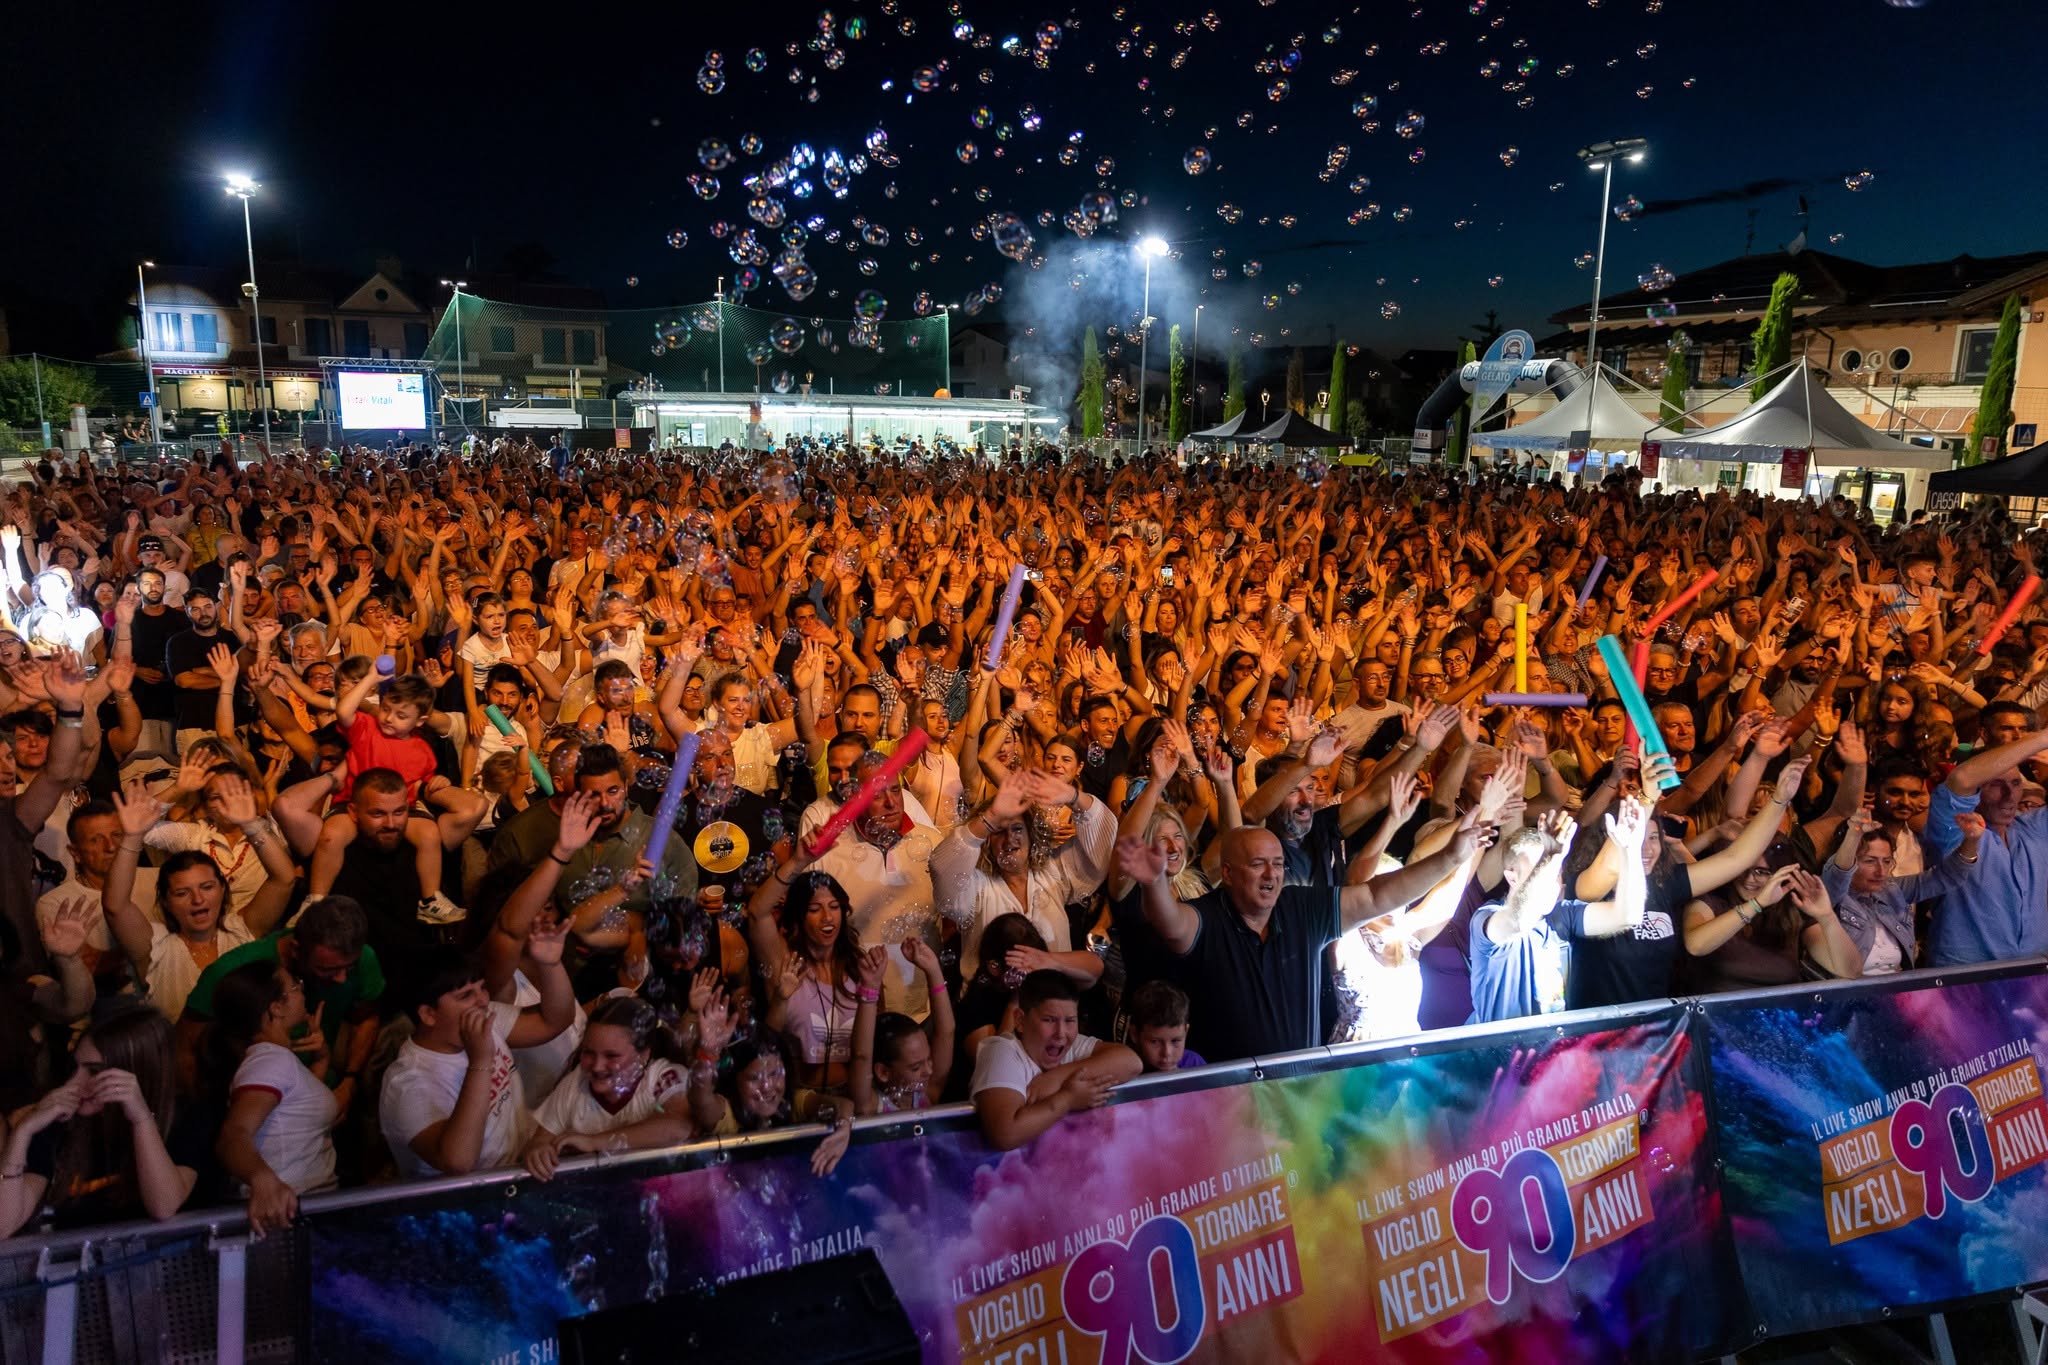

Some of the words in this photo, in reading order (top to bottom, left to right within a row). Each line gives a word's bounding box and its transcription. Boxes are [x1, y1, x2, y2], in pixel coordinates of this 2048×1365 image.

[1481, 371, 1511, 382] GELATO
[1930, 491, 1961, 510] CASSA
[1357, 1200, 1371, 1220] IL
[1375, 1185, 1404, 1214] LIVE
[1408, 1168, 1445, 1201] SHOW
[1448, 1153, 1478, 1183] ANNI
[1481, 1145, 1498, 1168] 90
[1501, 1130, 1523, 1160] PIÙ
[1527, 1114, 1579, 1147] GRANDE
[1581, 1093, 1637, 1129] D'ITALIA
[1811, 1122, 1823, 1141] IL
[1823, 1111, 1847, 1136] LIVE
[1849, 1097, 1883, 1125] SHOW
[1885, 1086, 1910, 1112] ANNI
[1911, 1080, 1927, 1100] 90
[1928, 1068, 1948, 1093] PIÙ
[1951, 1055, 1987, 1083] GRANDE
[1988, 1038, 2031, 1068] D'ITALIA
[1828, 1131, 1881, 1177] VOGLIO
[1976, 1064, 2038, 1113] TORNARE
[952, 1276, 966, 1300] IL
[972, 1260, 1006, 1293] LIVE
[1010, 1240, 1056, 1276] SHOW
[1064, 1224, 1101, 1257] ANNI
[1107, 1214, 1126, 1240] 90
[1130, 1197, 1155, 1229] PIÙ
[1160, 1176, 1218, 1214] GRANDE
[1222, 1152, 1284, 1192] D'ITALIA
[1374, 1206, 1441, 1261] VOGLIO
[1559, 1123, 1636, 1180] TORNARE
[1830, 1169, 1907, 1235] NEGLI
[1889, 1083, 1995, 1220] 90
[1996, 1107, 2048, 1171] ANNI
[968, 1282, 1046, 1345] VOGLIO
[1194, 1185, 1286, 1249] TORNARE
[1061, 1214, 1206, 1365] 90
[1215, 1239, 1292, 1321] ANNI
[1379, 1250, 1466, 1331] NEGLI
[1450, 1147, 1576, 1305] 90
[1583, 1170, 1643, 1243] ANNI
